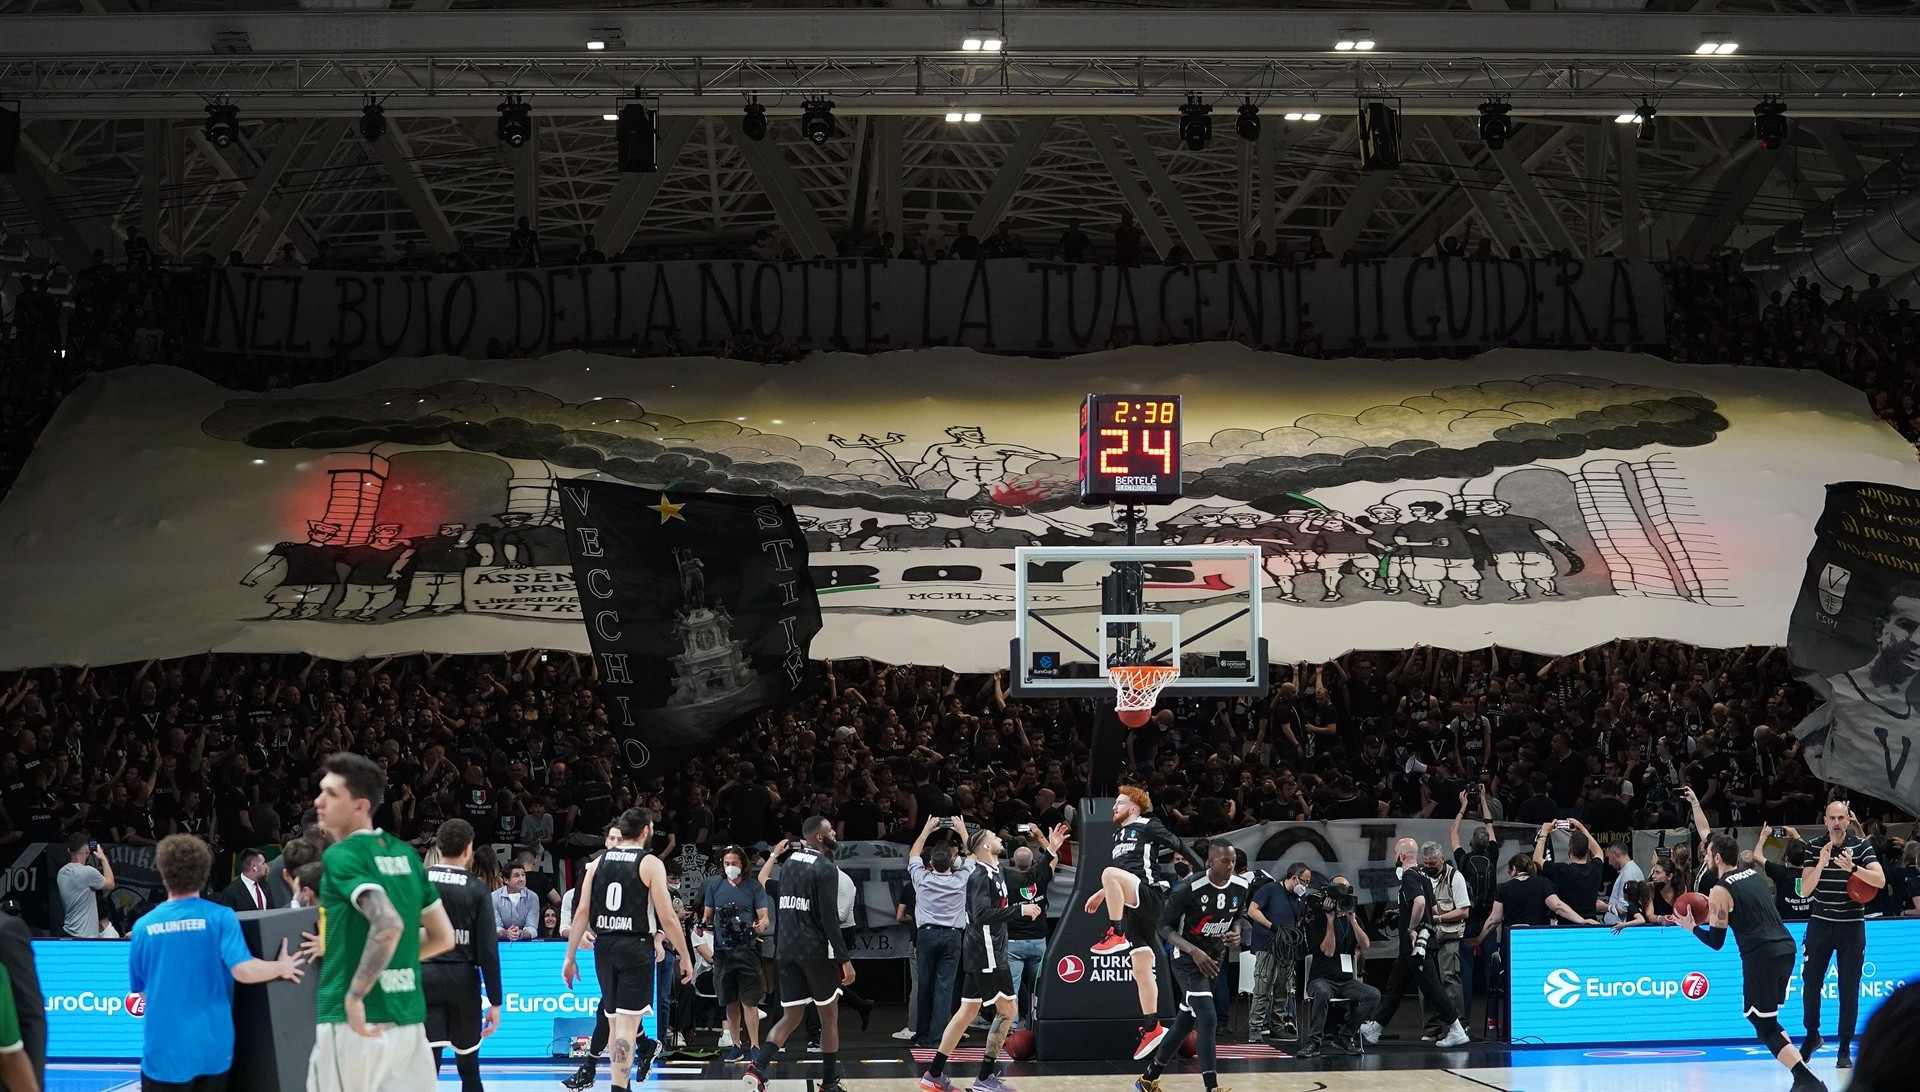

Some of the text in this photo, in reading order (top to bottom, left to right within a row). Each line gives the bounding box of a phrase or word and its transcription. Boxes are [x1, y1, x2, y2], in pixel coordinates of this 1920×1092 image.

[205, 267, 311, 352] NEL
[329, 274, 478, 357] BUIO
[505, 263, 684, 354] DELLA
[697, 258, 890, 350] NOTTE
[919, 258, 997, 348] LA
[1028, 262, 1142, 349] TUA
[1159, 262, 1317, 348] GENTE
[1114, 402, 1175, 423] 2:38
[1100, 429, 1171, 474] 24
[473, 572, 577, 585] ASSEN
[513, 583, 578, 594] PRE
[478, 603, 582, 612] ULTR
[753, 504, 804, 693] STILE
[563, 486, 650, 769] VECCHIO
[4, 866, 38, 893] 101
[427, 870, 468, 886] WEEMS
[605, 882, 623, 911] 0
[779, 895, 811, 912] BOLOGNA
[1216, 893, 1226, 909] 8
[146, 918, 207, 936] VOLUNTEER
[1090, 956, 1156, 968] TURK
[1090, 969, 1157, 982] AIRLIN
[1586, 976, 1679, 1000] EuroCup
[505, 992, 601, 1016] EuroCup
